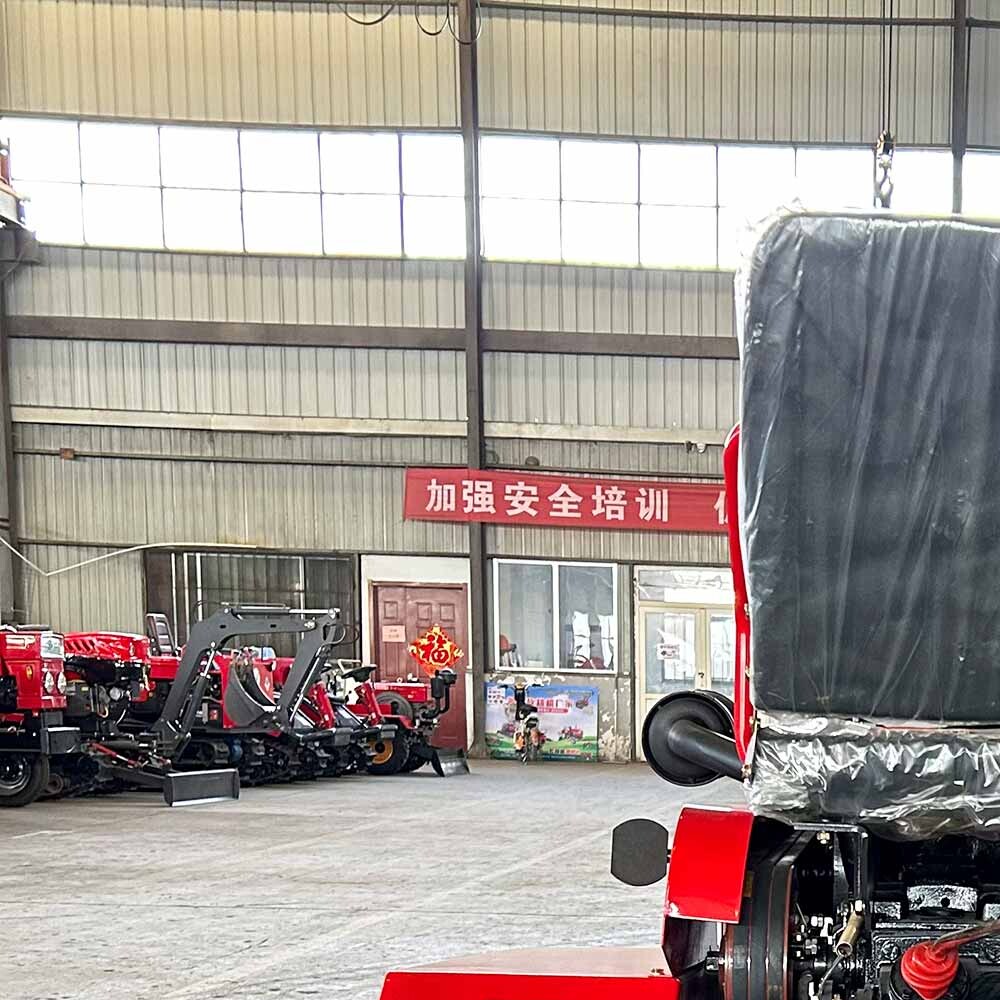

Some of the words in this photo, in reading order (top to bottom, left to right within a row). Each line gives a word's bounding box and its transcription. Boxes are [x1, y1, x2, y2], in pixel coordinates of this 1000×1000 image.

[425, 479, 669, 523] 加强安全培训
[420, 633, 451, 666] 福
